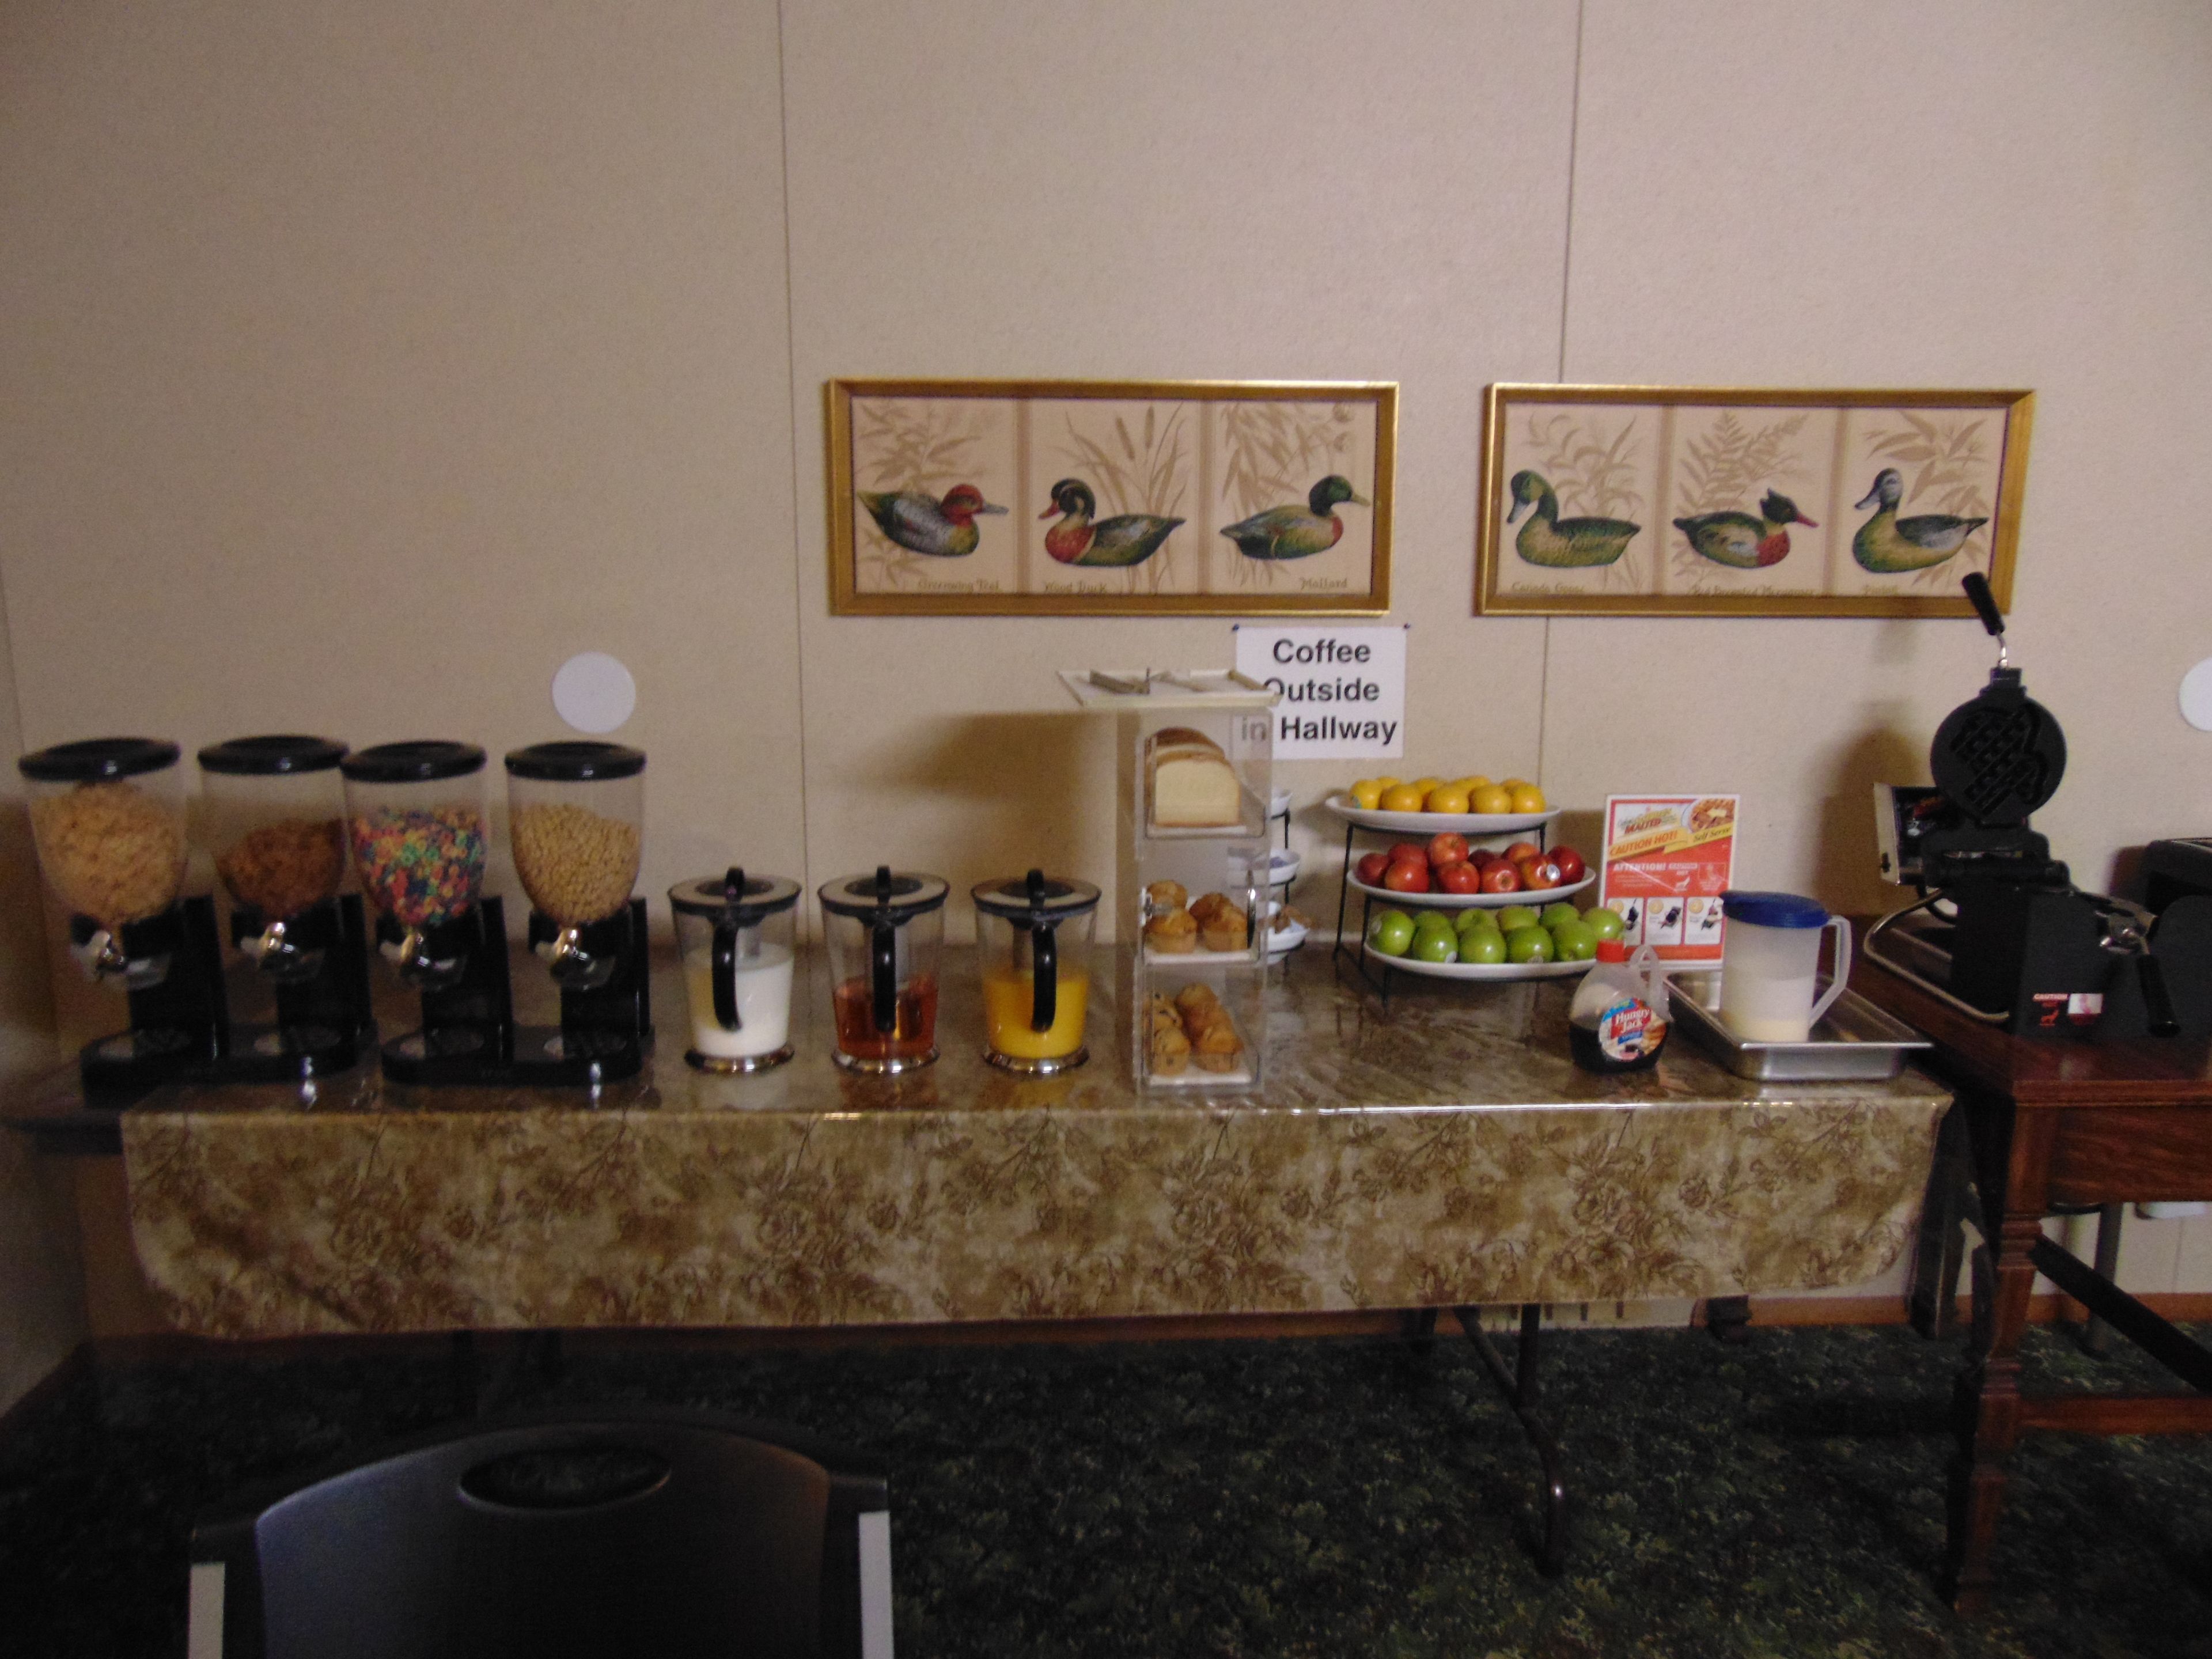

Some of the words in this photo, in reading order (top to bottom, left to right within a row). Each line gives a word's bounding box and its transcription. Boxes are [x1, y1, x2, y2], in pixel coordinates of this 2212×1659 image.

[1300, 577, 1347, 590] Mallard
[1272, 638, 1371, 663] Coffee
[1264, 677, 1380, 701] Outside
[1241, 717, 1267, 740] in
[1281, 716, 1397, 746] Hallway
[1694, 832, 1709, 842] Self
[1609, 837, 1652, 855] CAUTION
[1615, 1009, 1650, 1025] Hungry
[1621, 1018, 1643, 1033] Jack
